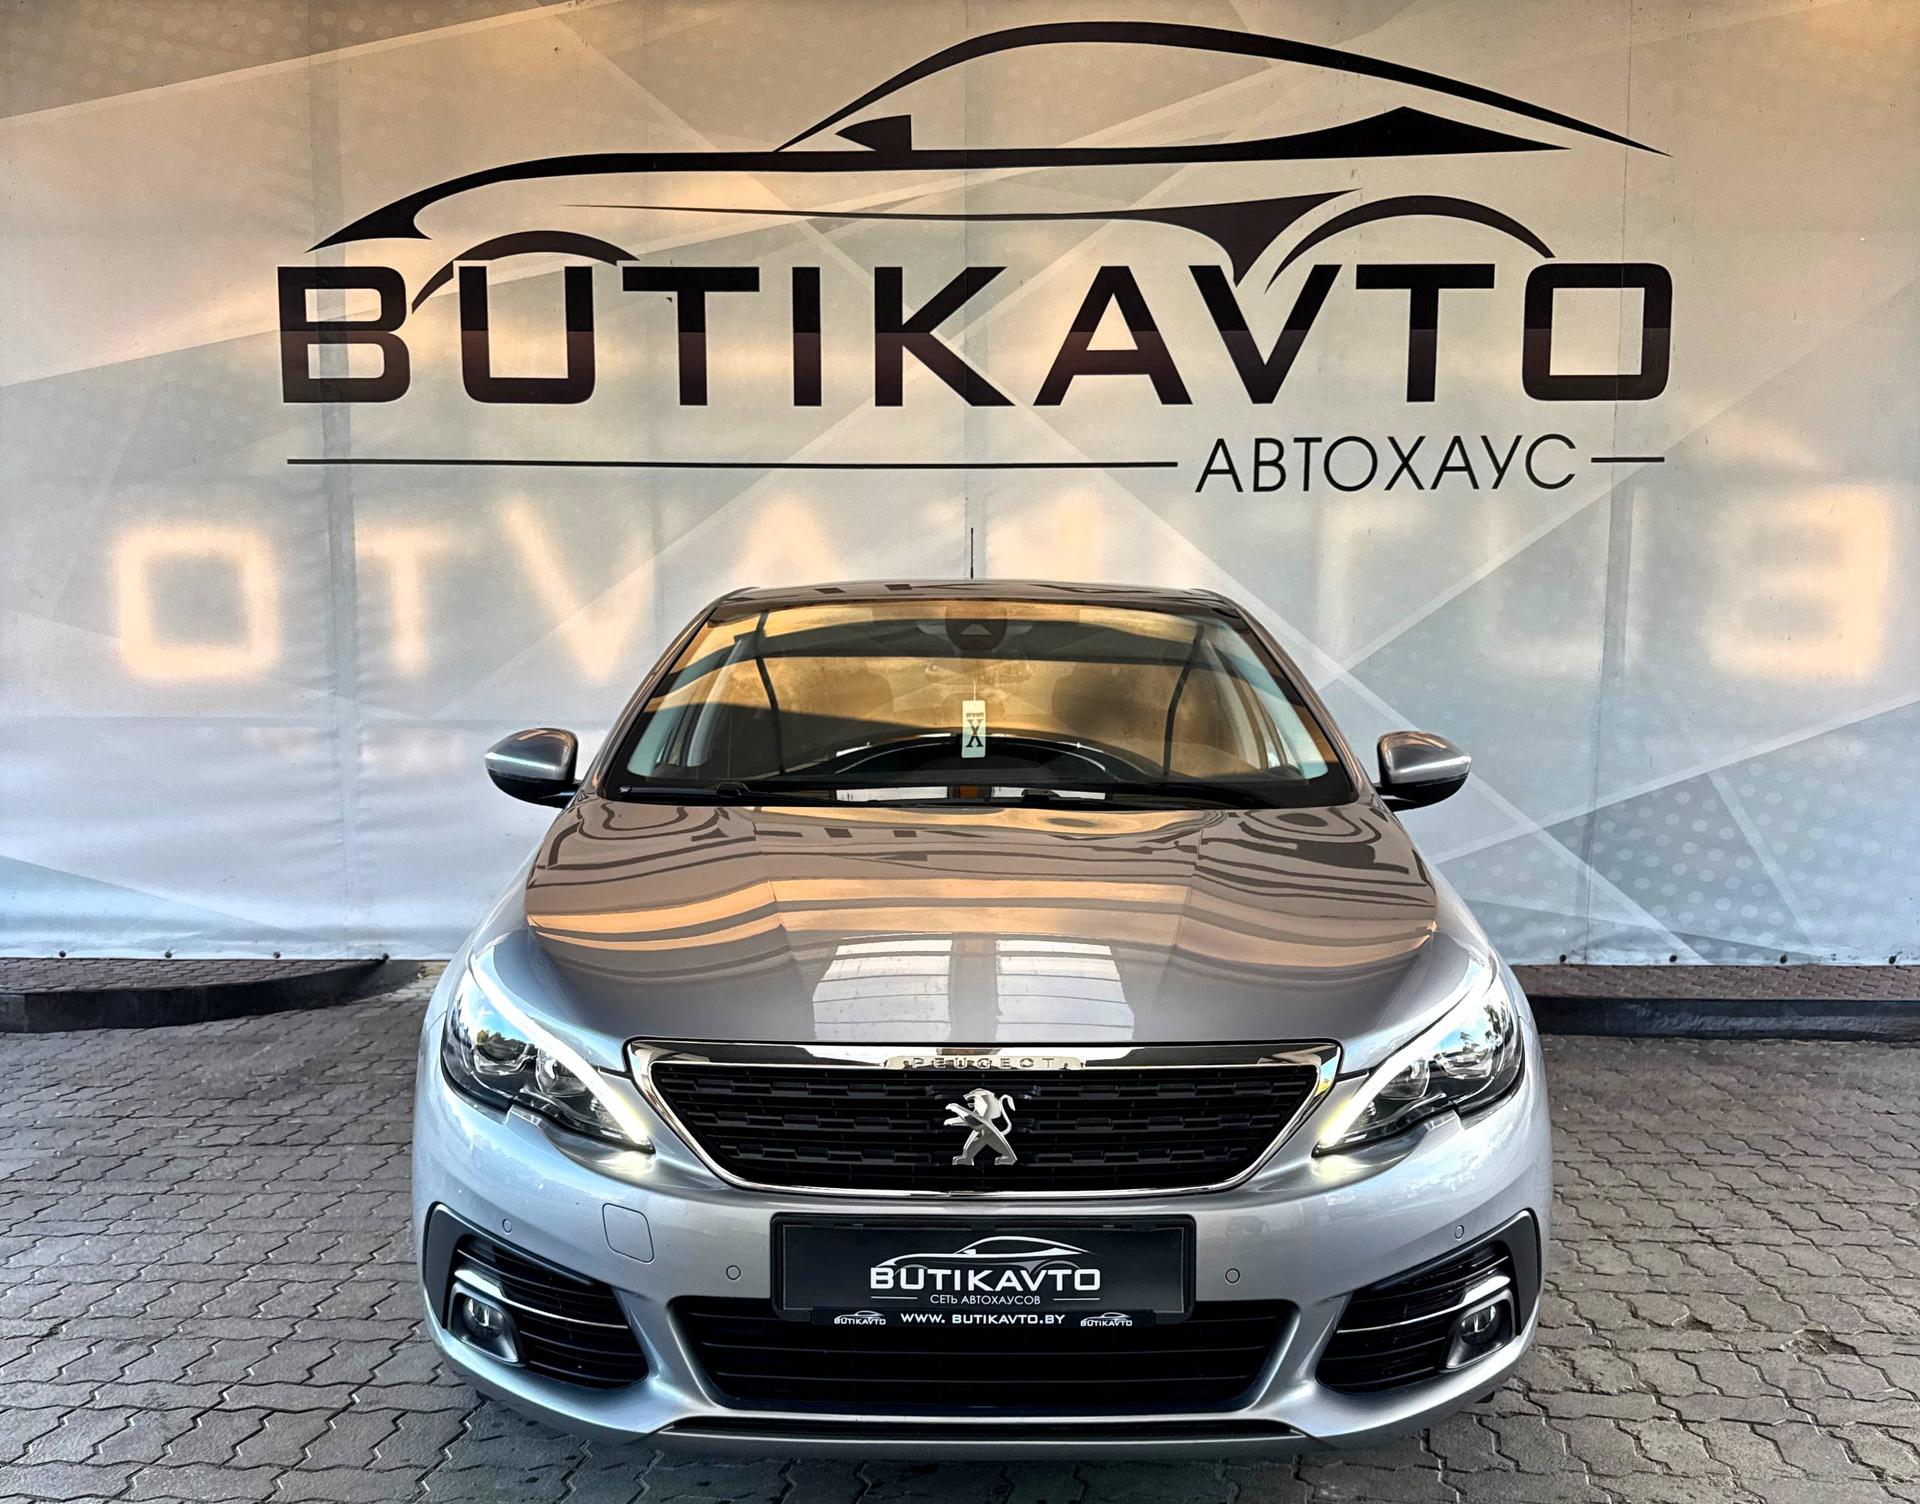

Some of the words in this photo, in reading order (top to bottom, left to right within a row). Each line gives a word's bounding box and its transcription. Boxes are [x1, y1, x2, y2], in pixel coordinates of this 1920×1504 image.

[277, 262, 1673, 408] BUTIKAVTO
[1194, 433, 1577, 493] АВТОХАУС
[911, 1057, 1055, 1069] PEUGEOT
[870, 1267, 1101, 1292] BUTIKAVTO
[929, 1294, 958, 1305] СЕТЬ
[960, 1294, 1042, 1306] АВТОХАУСОВ
[833, 1316, 887, 1326] BUTIKAVTO
[900, 1313, 946, 1324] WWW.
[951, 1313, 1066, 1325] BUTIKAVTO.BY
[1080, 1319, 1133, 1327] BUTIKAVTO
